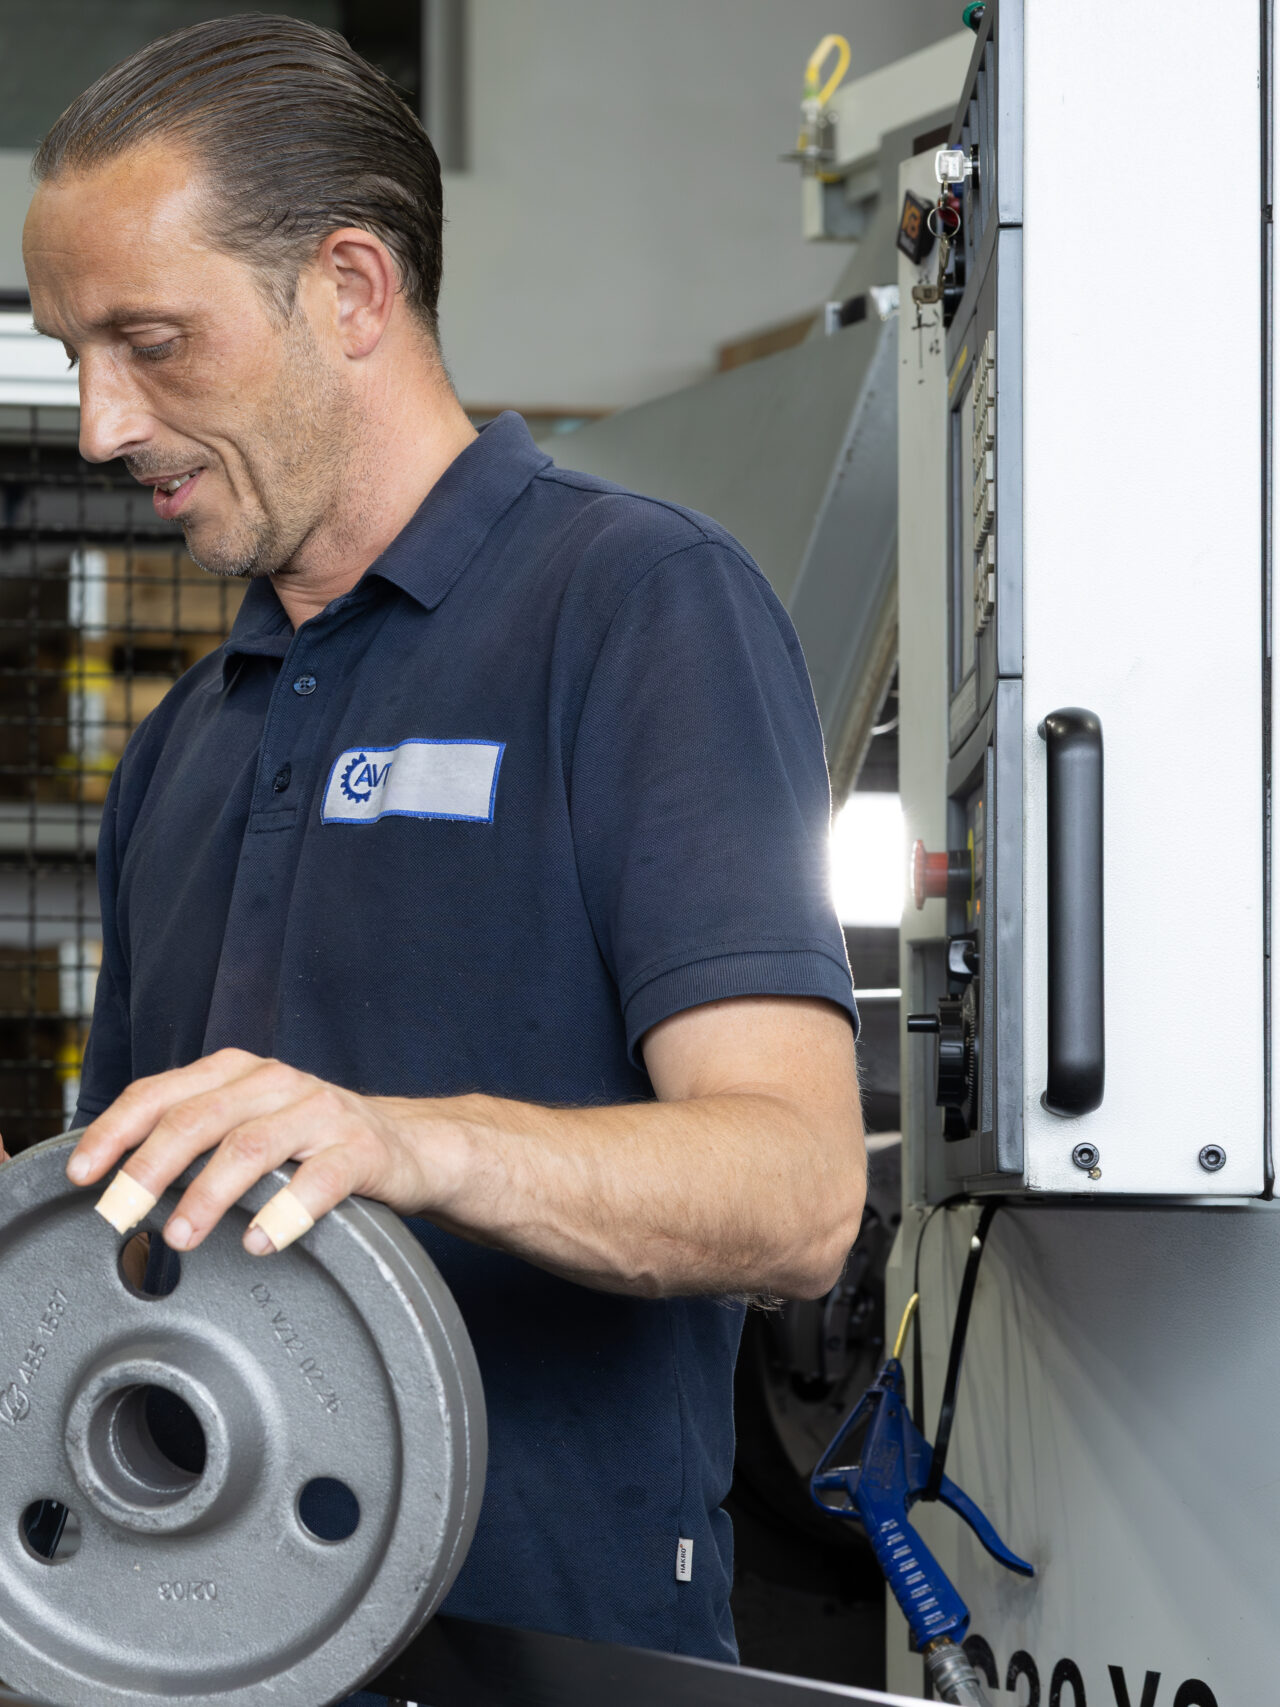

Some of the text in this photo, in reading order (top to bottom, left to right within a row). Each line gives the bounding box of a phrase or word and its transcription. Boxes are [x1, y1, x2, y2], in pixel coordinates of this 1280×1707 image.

[18, 1286, 68, 1384] 455 1537
[269, 1310, 304, 1357] VZ12
[299, 1357, 324, 1386] 02
[316, 1386, 344, 1413] 26
